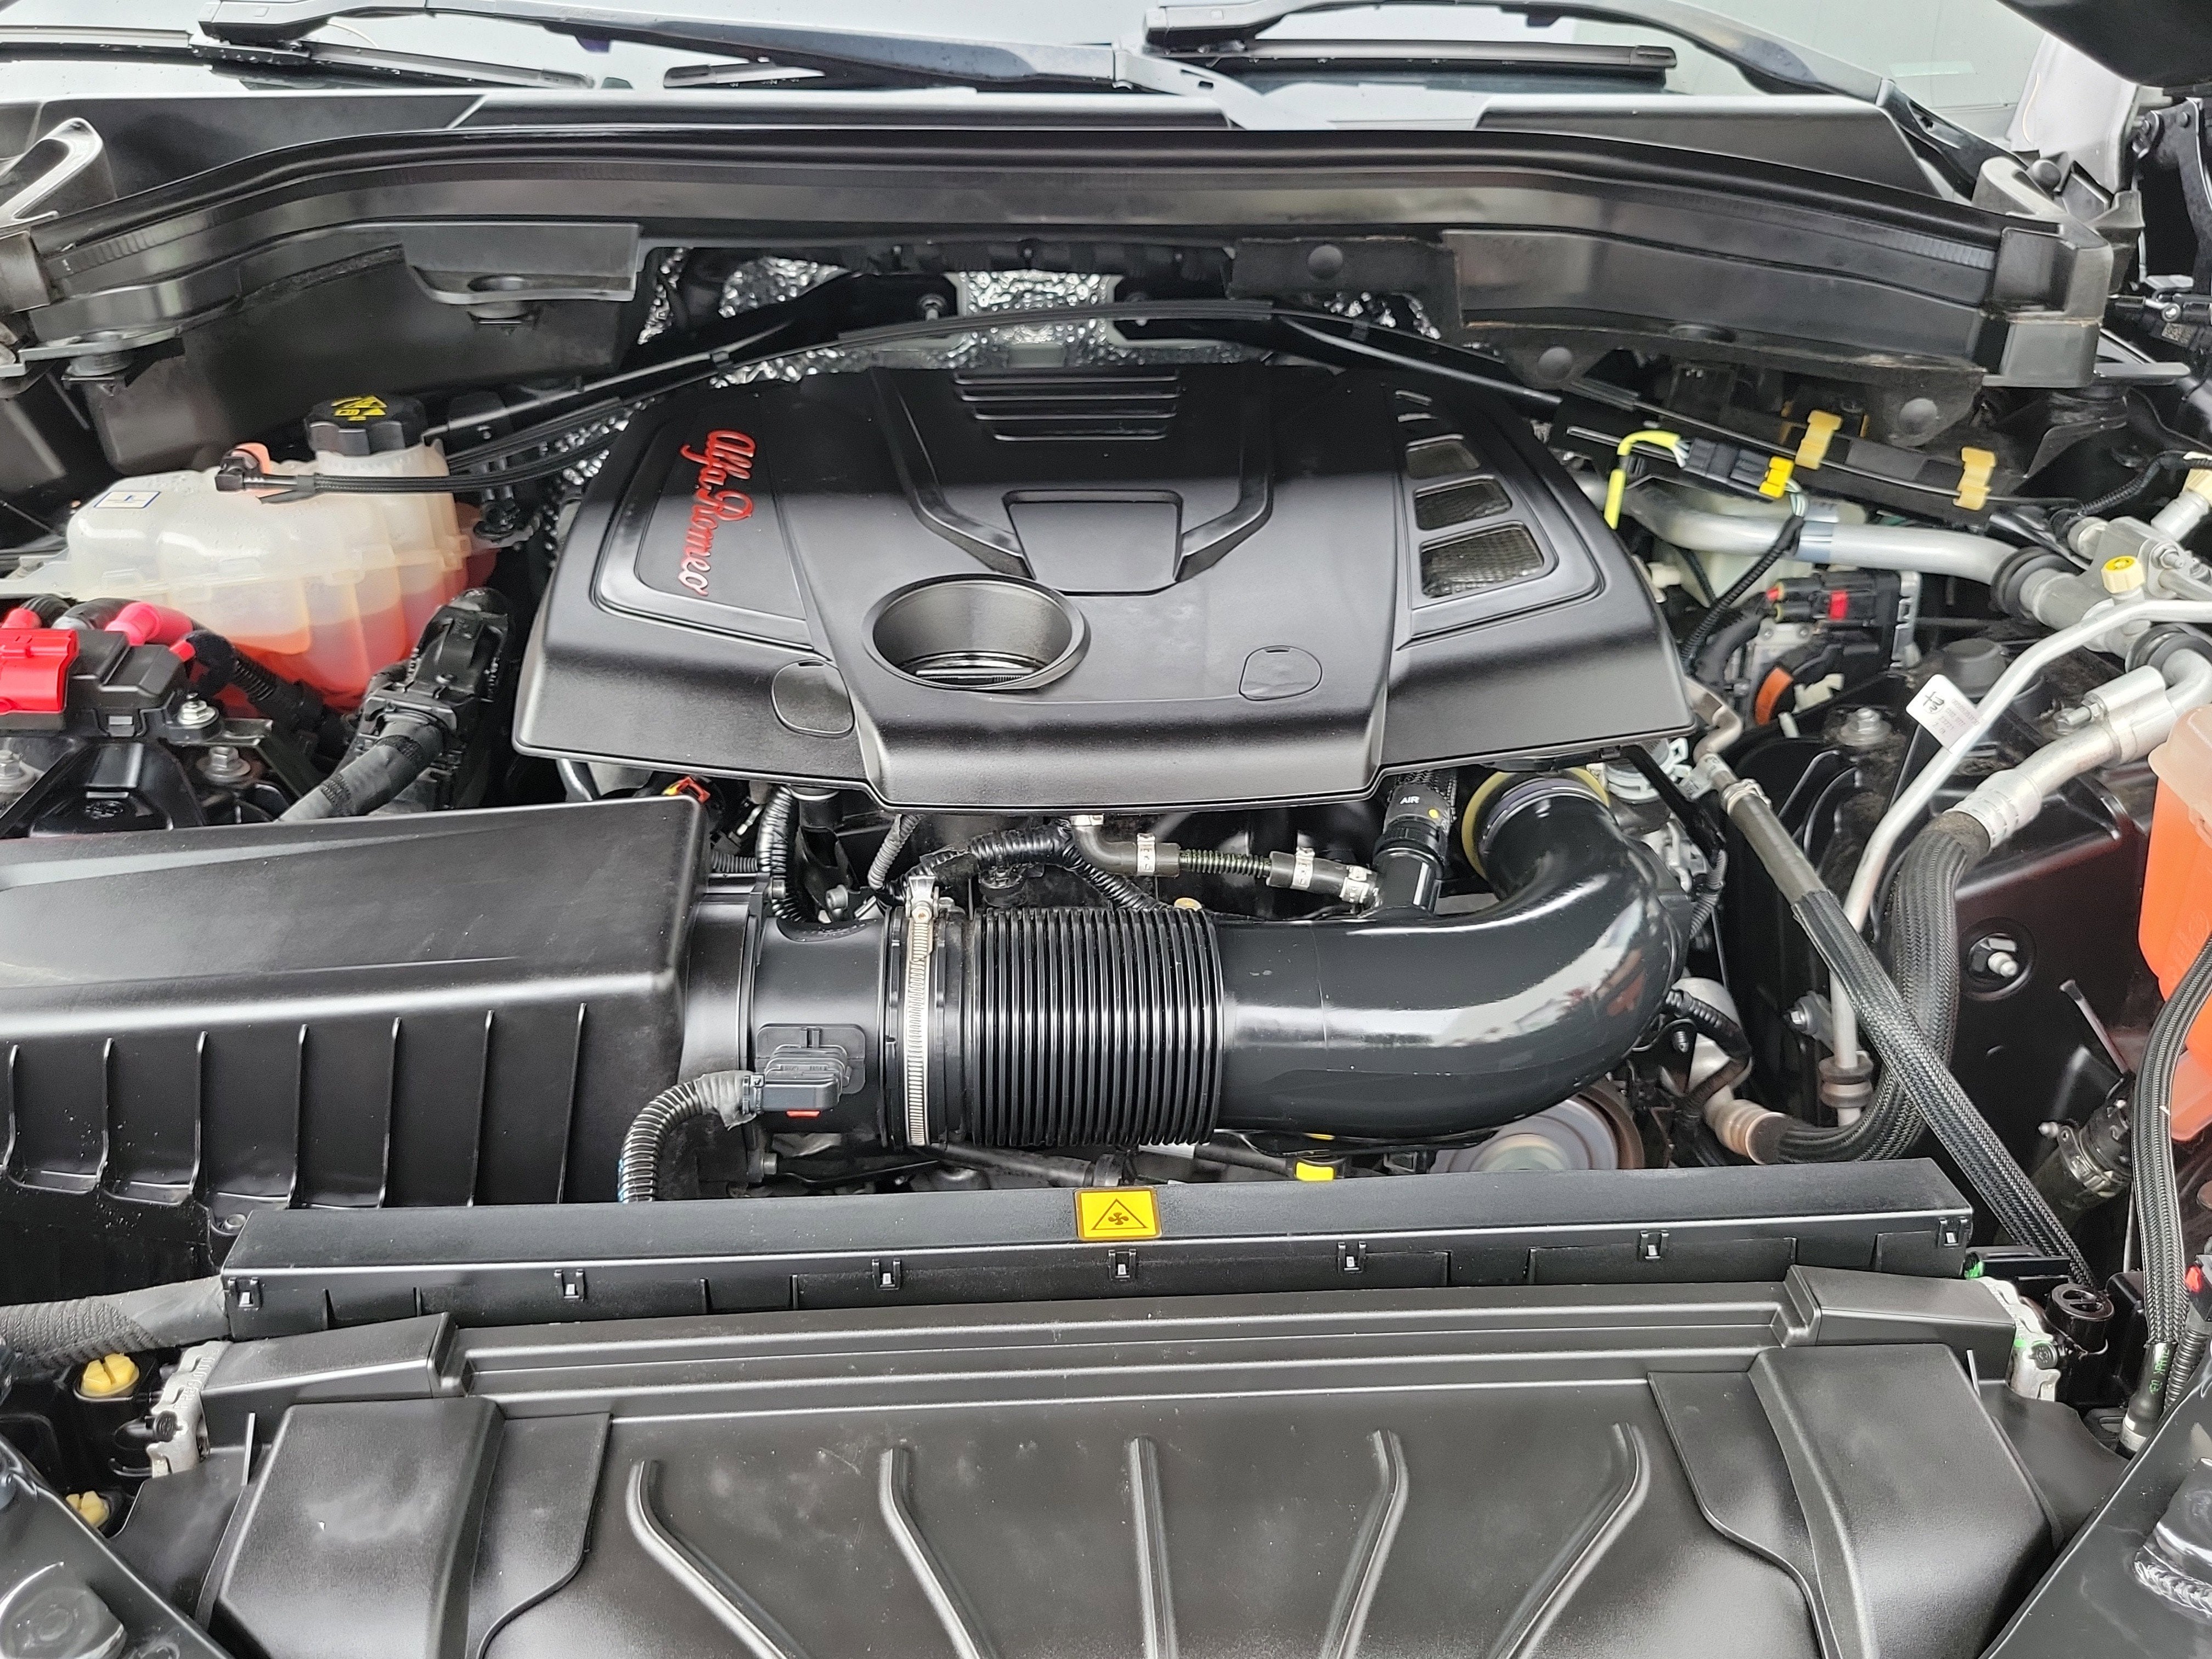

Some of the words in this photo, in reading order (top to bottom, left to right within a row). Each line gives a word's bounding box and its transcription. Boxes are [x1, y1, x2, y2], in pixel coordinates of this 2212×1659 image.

[680, 430, 756, 489] Alfa
[679, 488, 753, 596] Romeo
[1400, 796, 1420, 804] AIR
